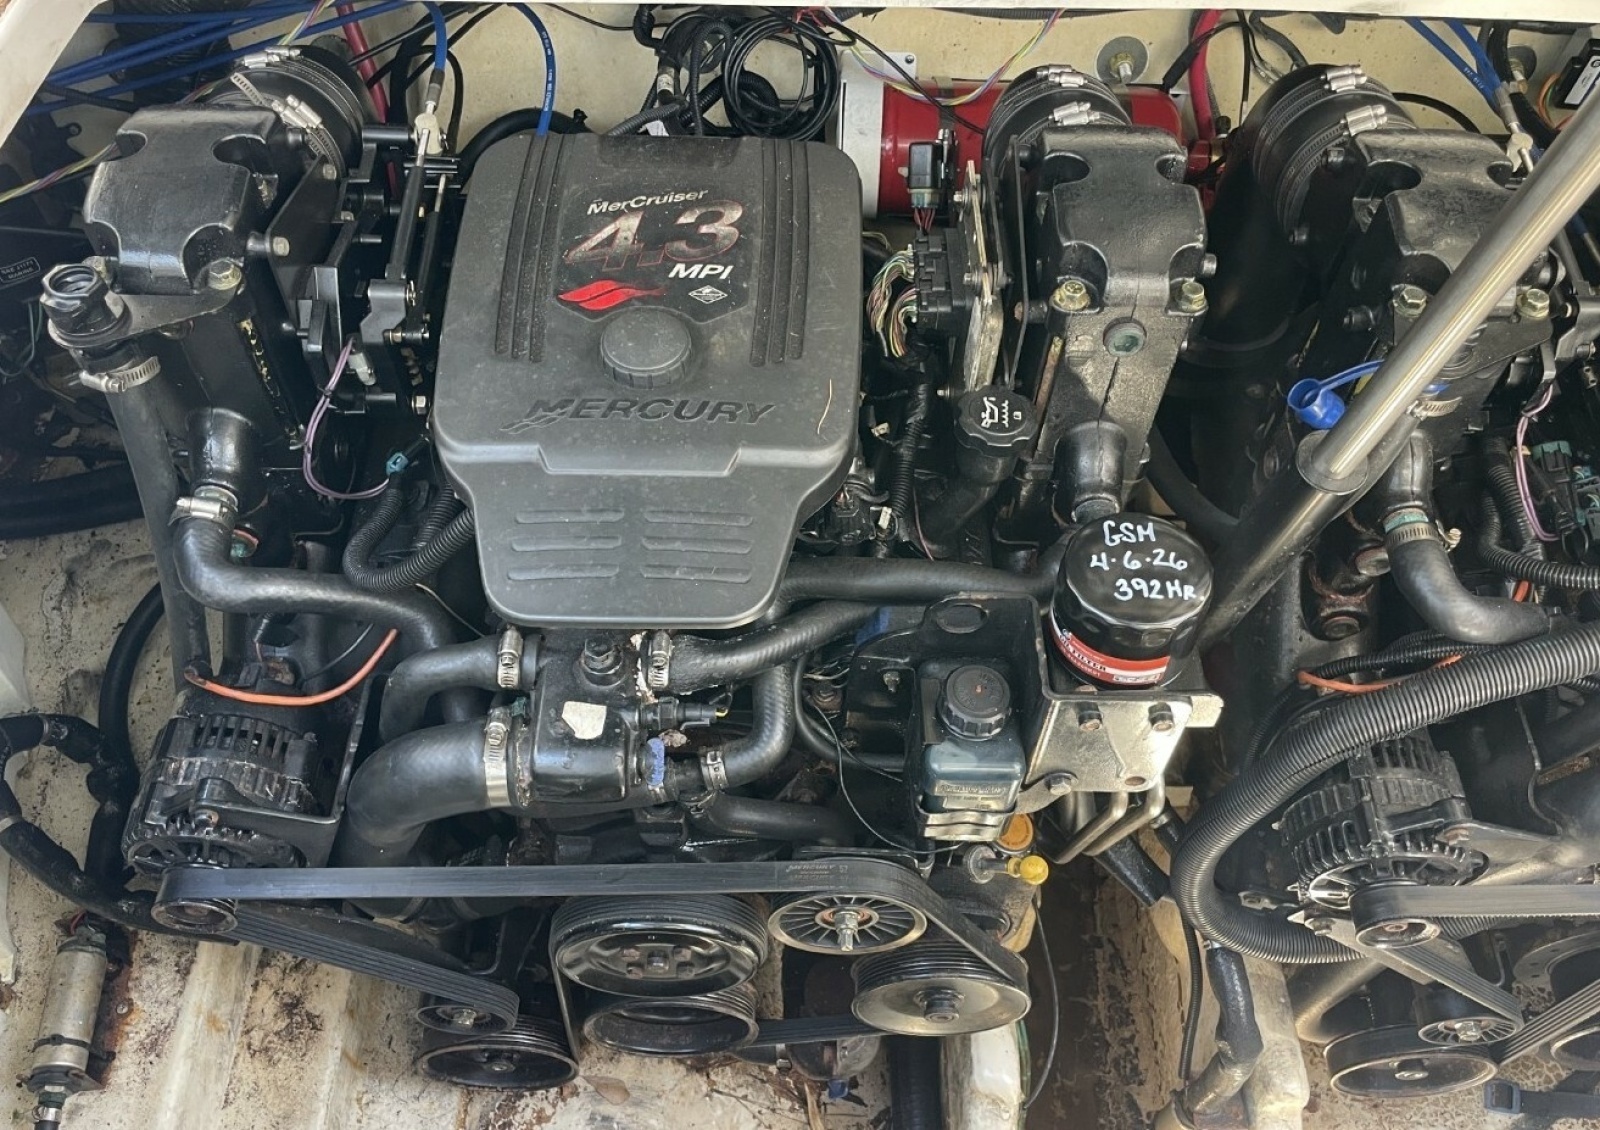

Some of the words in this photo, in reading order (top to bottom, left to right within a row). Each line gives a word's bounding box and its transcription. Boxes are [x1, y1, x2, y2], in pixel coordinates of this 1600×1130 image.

[587, 189, 708, 215] MerCruiser
[668, 263, 734, 280] MPI
[505, 397, 776, 431] MERCURY
